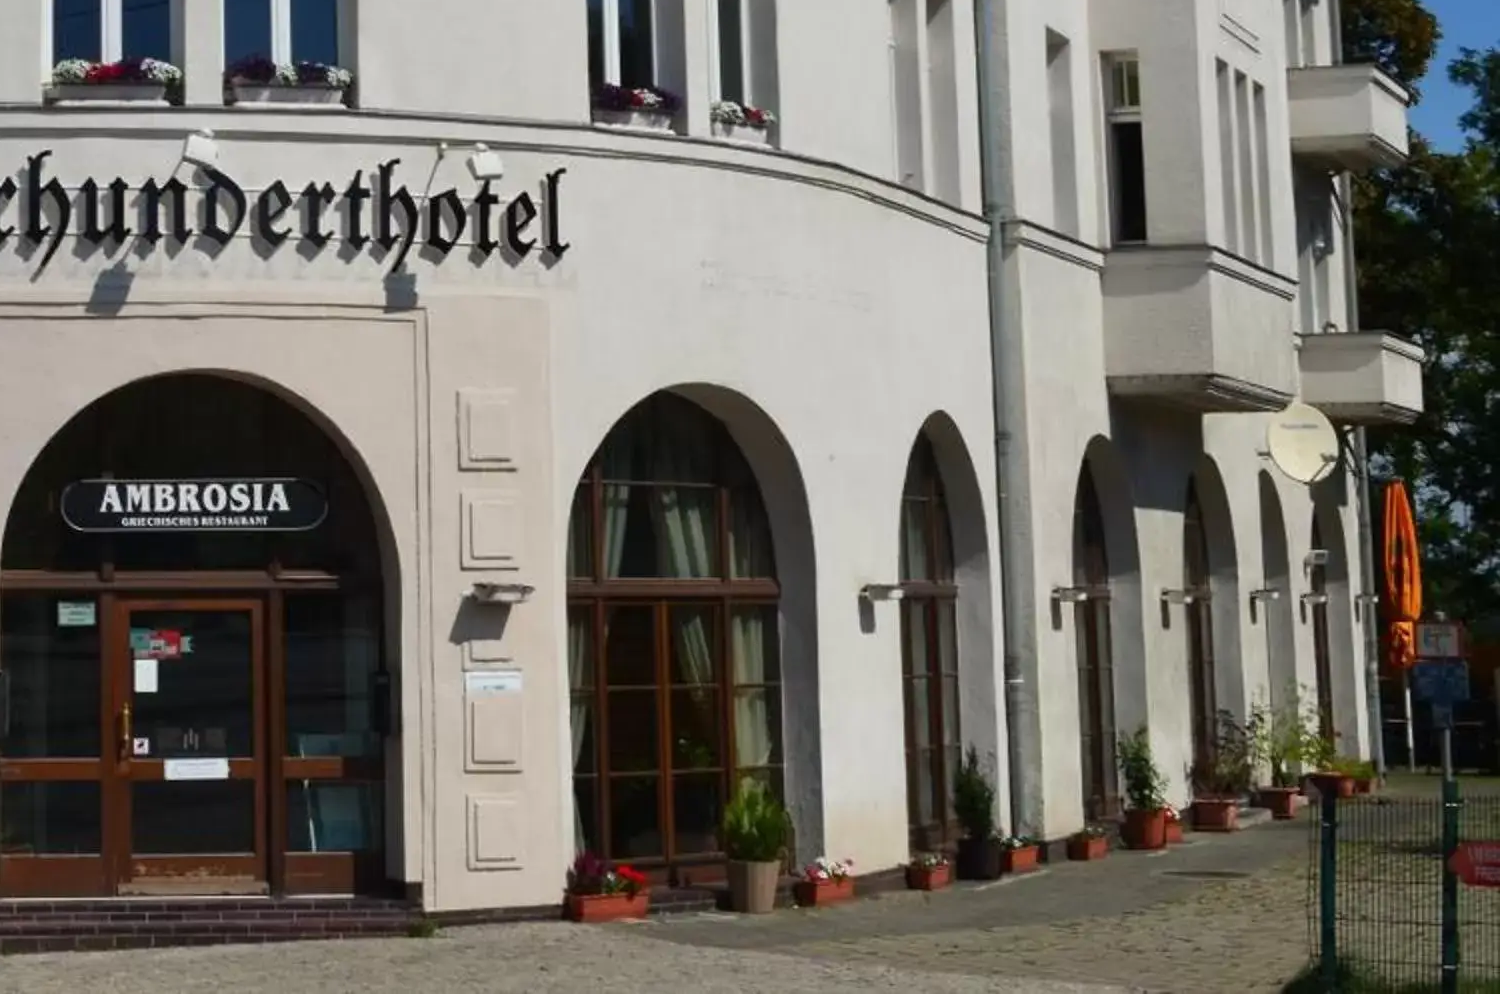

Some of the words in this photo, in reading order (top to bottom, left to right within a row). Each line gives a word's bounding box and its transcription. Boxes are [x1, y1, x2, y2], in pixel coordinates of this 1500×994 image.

[99, 483, 290, 513] AMBROSIA
[121, 515, 199, 528] GRIECHISCHES
[201, 515, 269, 527] RESTAURANT
